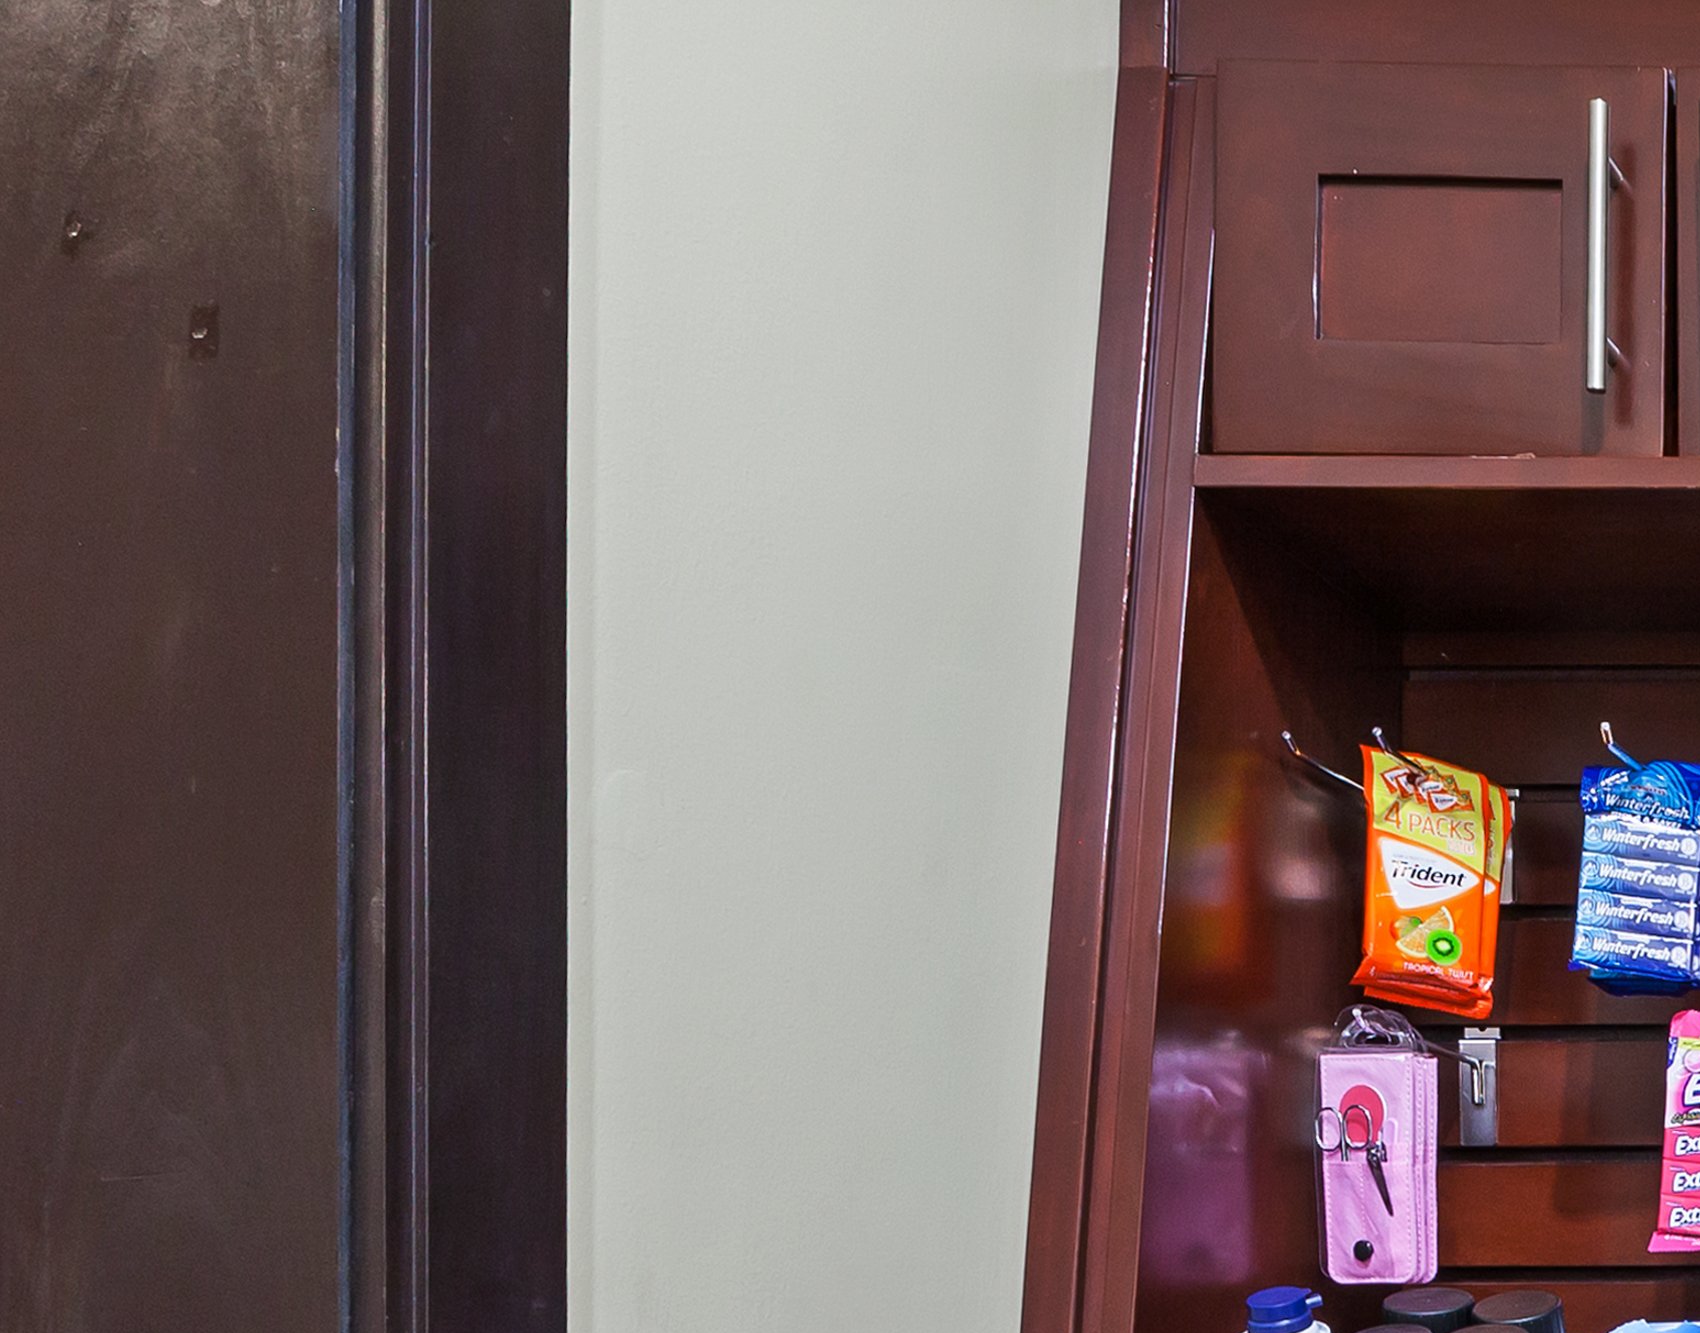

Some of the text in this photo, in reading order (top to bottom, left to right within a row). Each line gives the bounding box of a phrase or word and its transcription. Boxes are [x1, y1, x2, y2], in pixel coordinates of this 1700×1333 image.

[1384, 806, 1475, 842] 4 PACKS
[1602, 828, 1680, 852] Winterfresh
[1392, 860, 1467, 888] Trident
[1403, 962, 1474, 981] TROPICAL TWIST
